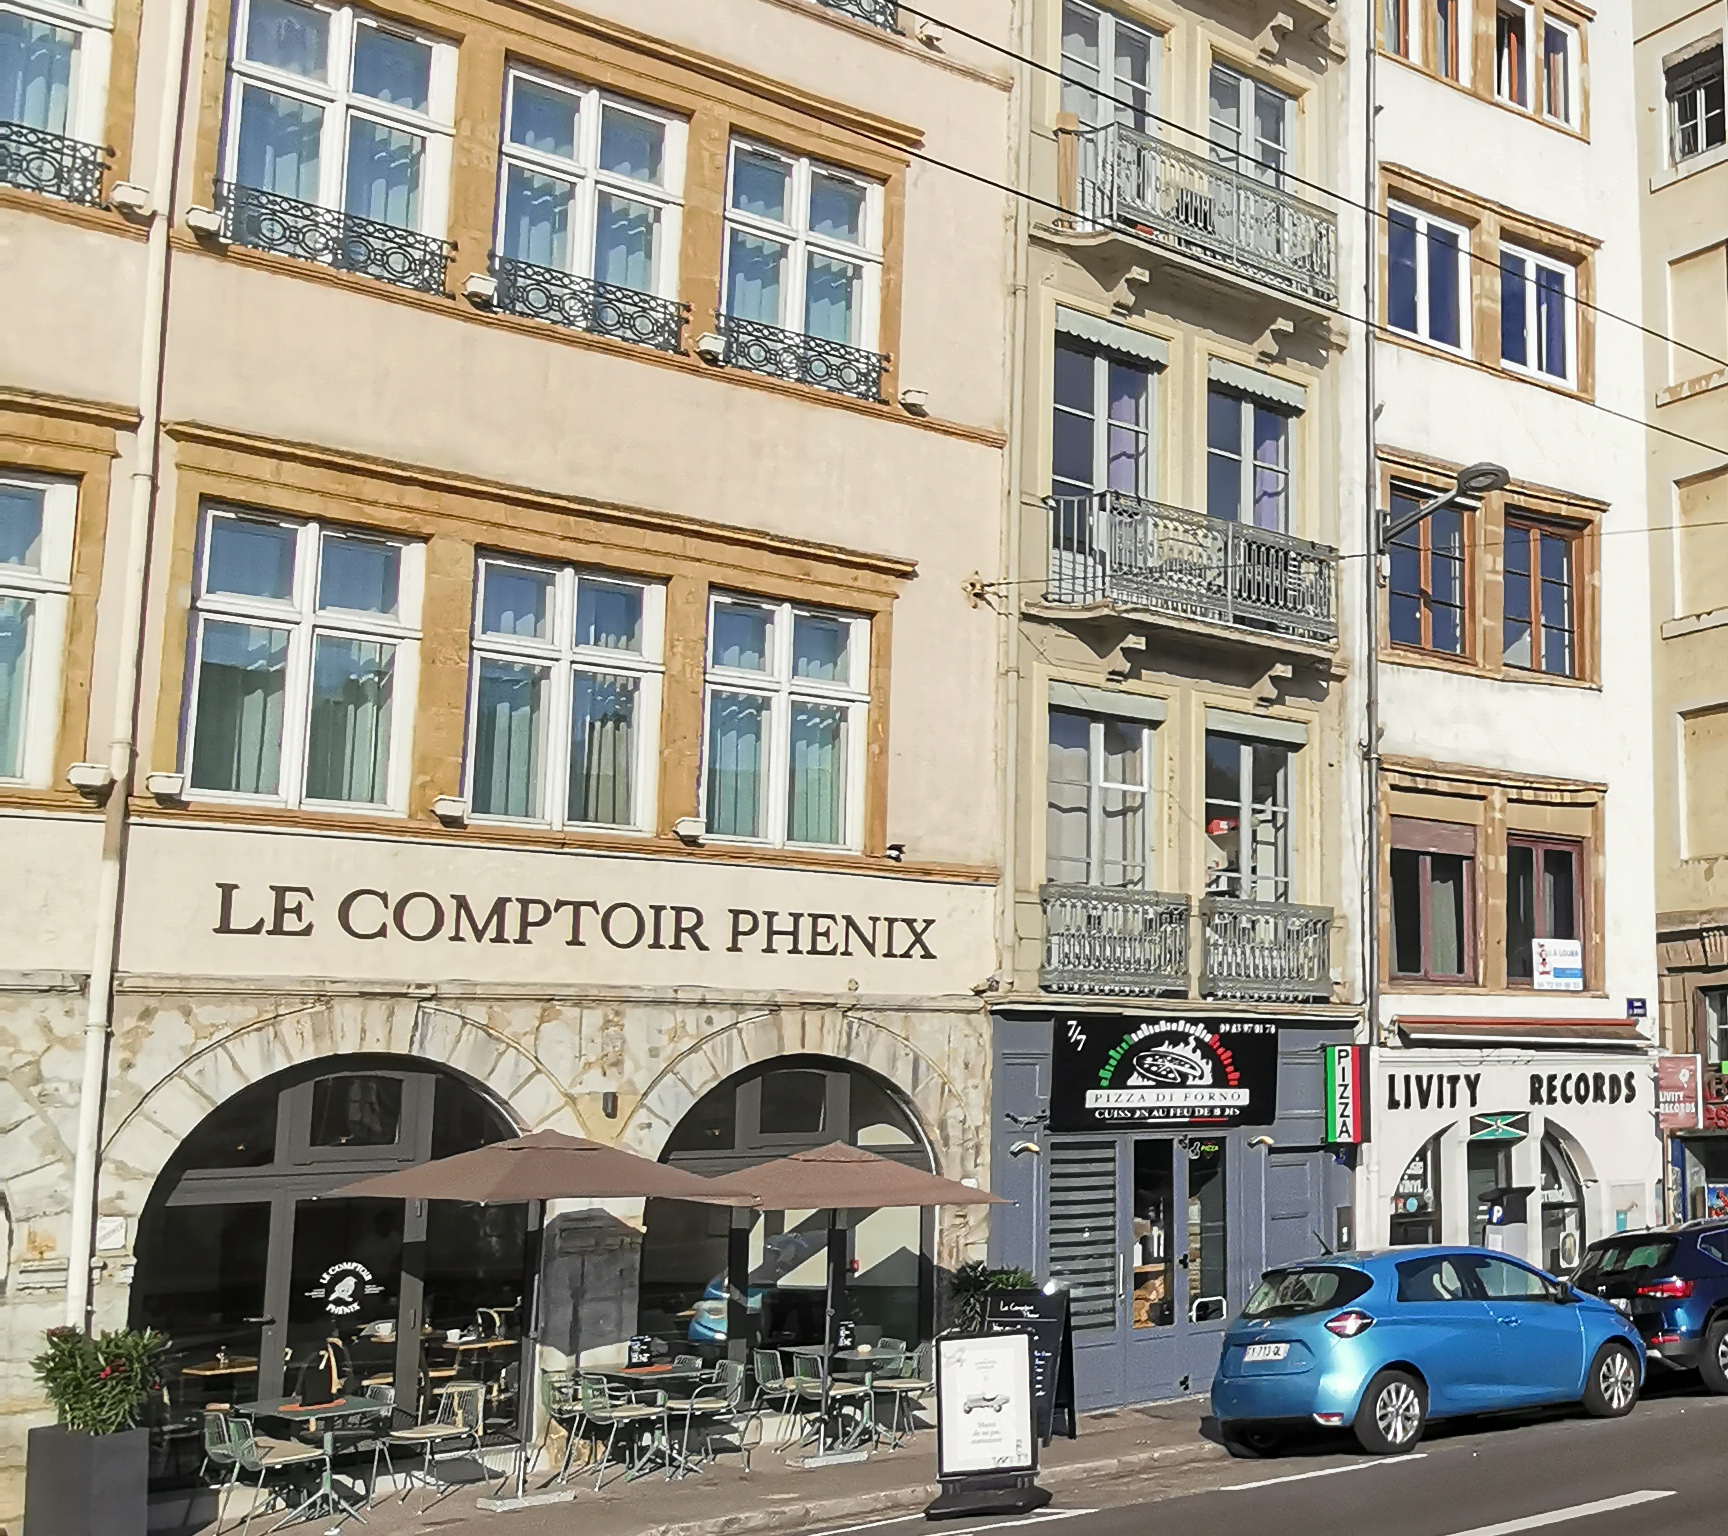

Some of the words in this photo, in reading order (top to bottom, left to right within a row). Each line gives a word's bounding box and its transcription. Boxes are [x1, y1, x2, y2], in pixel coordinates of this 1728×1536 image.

[212, 882, 315, 937] LE
[337, 888, 711, 951] COMPTOIR
[725, 908, 938, 960] PHENIX
[1094, 1092, 1146, 1104] PIZZA
[1156, 1092, 1175, 1102] DI
[1184, 1091, 1241, 1102] FORNO
[1337, 1048, 1352, 1139] PIZZA
[1387, 1072, 1482, 1110] LIVITY
[1528, 1071, 1637, 1105] RECORDS
[1660, 1091, 1685, 1102] LIVITY
[1660, 1102, 1696, 1114] RECORDS
